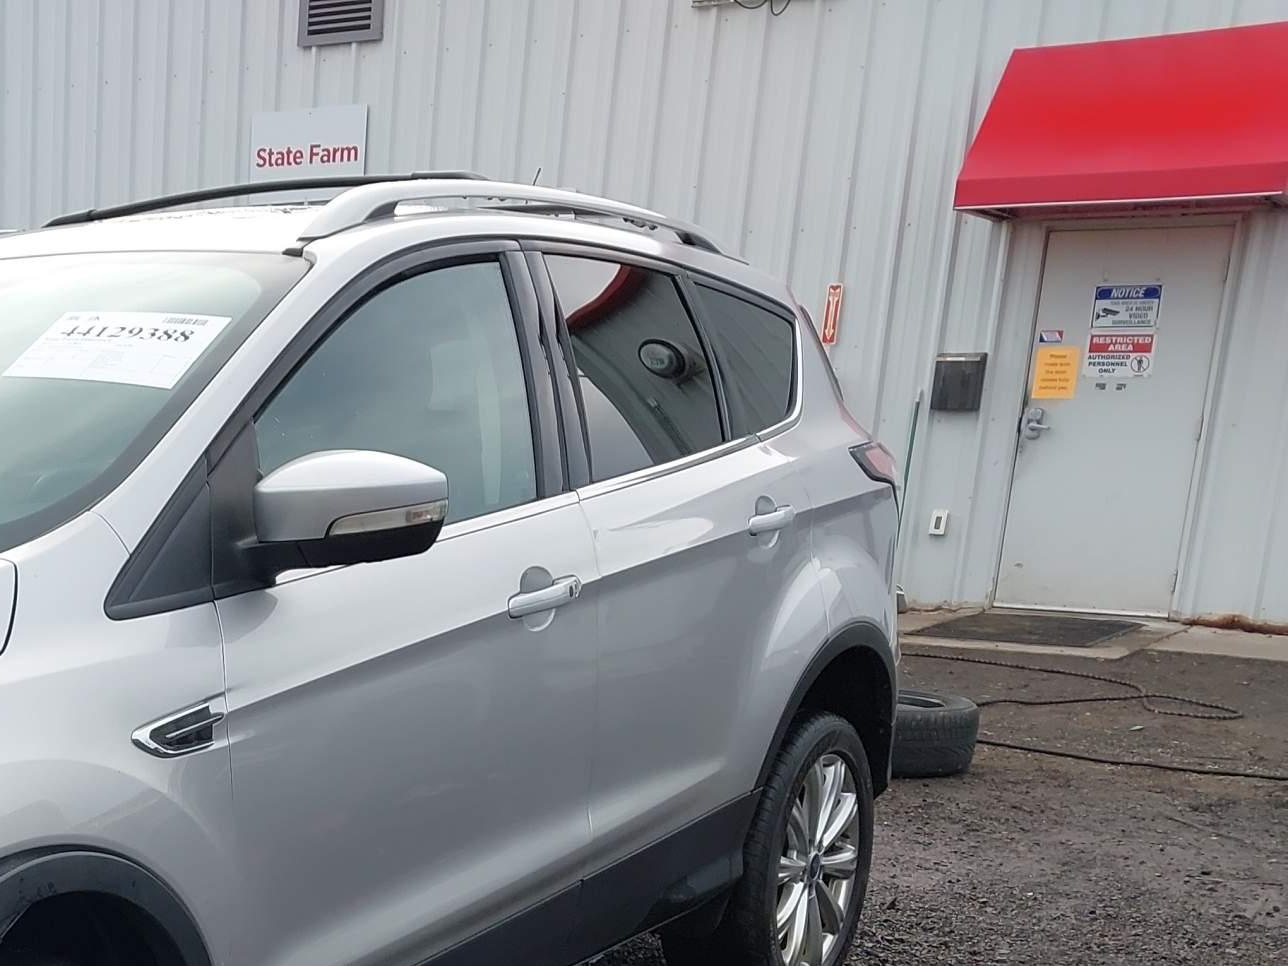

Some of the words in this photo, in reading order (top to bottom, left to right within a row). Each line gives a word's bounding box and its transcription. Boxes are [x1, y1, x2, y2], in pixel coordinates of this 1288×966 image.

[255, 146, 304, 168] State
[309, 144, 359, 165] Farm
[1111, 287, 1146, 298] NOTICE
[59, 324, 195, 343] 44129388
[1092, 336, 1152, 344] RESTRICTED
